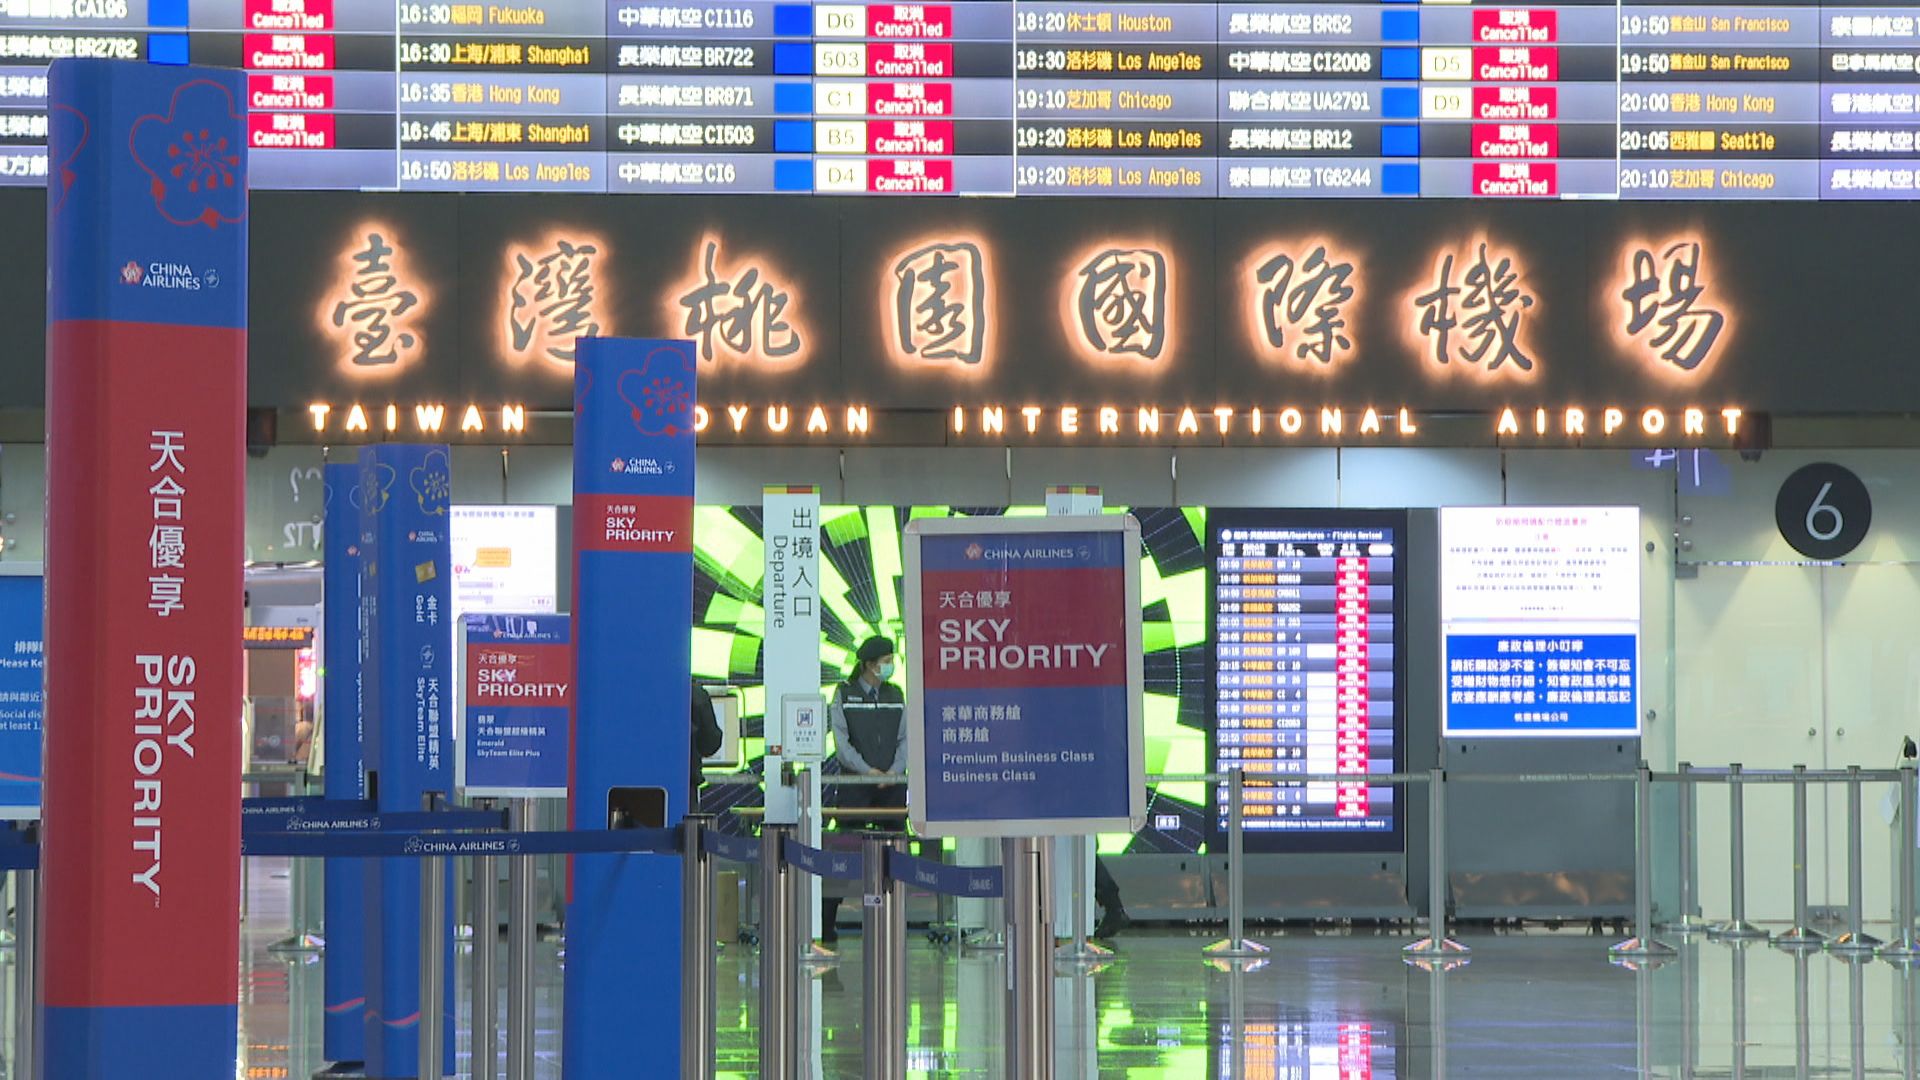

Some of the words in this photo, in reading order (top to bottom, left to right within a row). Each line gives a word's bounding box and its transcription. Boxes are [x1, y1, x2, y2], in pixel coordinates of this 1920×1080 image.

[252, 12, 324, 29] Cancelled
[401, 5, 451, 24] 16:30
[489, 6, 544, 24] Fukuoka
[704, 9, 754, 28] CI116
[828, 13, 854, 28] D6
[1017, 12, 1065, 32] 18:20
[1118, 14, 1172, 32] Houston
[1621, 15, 1669, 35] 19:50
[1711, 16, 1730, 32] San
[1734, 16, 1790, 32] Francisco
[875, 21, 943, 37] Cancelled
[1480, 26, 1548, 41] Cancelled
[252, 51, 324, 68] Cancelled
[401, 43, 451, 62] 16:30
[528, 44, 590, 66] Shanghai
[704, 47, 754, 66] BR722
[823, 52, 859, 67] 503
[1017, 50, 1065, 70] 18:30
[1118, 52, 1142, 70] Los
[1148, 52, 1202, 72] Angeles
[1434, 56, 1460, 72] D5
[1621, 54, 1669, 73] 19:50
[1711, 55, 1730, 70] San
[1734, 55, 1790, 70] Francisco
[875, 60, 943, 75] Cancelled
[1480, 64, 1548, 80] Cancelled
[253, 92, 324, 108] Cancelled
[401, 83, 451, 102] 16:35
[490, 85, 521, 104] Hong
[528, 85, 560, 104] Kong
[827, 90, 853, 106] C1
[1017, 89, 1065, 108] 19:10
[1118, 90, 1172, 109] Chicago
[1313, 92, 1370, 111] UA2791
[1434, 95, 1460, 111] D9
[1621, 93, 1669, 112] 20:00
[1706, 94, 1737, 113] Hong
[1743, 94, 1774, 113] Kong
[875, 99, 943, 114] Cancelled
[1480, 103, 1548, 118] Cancelled
[253, 131, 324, 147] Cancelled
[401, 121, 451, 141] 16:45
[528, 123, 590, 144] Shanghai
[829, 129, 854, 145] B5
[1017, 128, 1065, 147] 19:20
[1118, 129, 1142, 147] Los
[1148, 129, 1202, 149] Angeles
[1313, 130, 1352, 150] BR12
[1621, 131, 1669, 150] 20:05
[1721, 132, 1775, 150] Seattle
[875, 138, 943, 153] Cancelled
[1480, 141, 1548, 156] Cancelled
[401, 161, 451, 180] 16:50
[505, 162, 529, 180] Los
[536, 162, 590, 182] Angeles
[704, 164, 736, 183] CI6
[828, 167, 853, 184] D4
[1017, 167, 1065, 185] 19:20
[1118, 167, 1142, 185] Los
[1148, 167, 1202, 187] Angeles
[1621, 170, 1669, 188] 20:10
[1721, 170, 1774, 189] Chicago
[875, 176, 943, 191] Cancelled
[1480, 179, 1548, 194] Cancelled
[150, 263, 192, 276] CHINA
[142, 274, 200, 290] AIRLINES
[309, 404, 525, 433] TAIWAN
[694, 405, 868, 433] OYUAN
[954, 406, 1417, 436] INTERNATIONAL
[1497, 406, 1743, 436] AIRPORT
[624, 465, 662, 475] AIRLINES
[629, 459, 657, 467] CHINA
[1805, 482, 1844, 541] 6
[148, 430, 186, 617] 天合優享
[606, 517, 636, 528] SKY
[606, 529, 674, 542] PRIORITY
[792, 507, 813, 616] 出境入口
[985, 549, 1021, 560] CHINA
[1023, 548, 1074, 560] AIRLINES
[769, 536, 788, 629] Departure
[939, 591, 1011, 609] 天合優享
[415, 595, 424, 623] Gold
[427, 595, 437, 626] 金卡
[939, 618, 1011, 643] SKY
[939, 643, 1108, 671] PRIORITY
[477, 669, 516, 682] SKY
[477, 683, 568, 697] PRIORITY
[167, 655, 196, 758] SKY
[416, 677, 425, 732] SkyTeam
[942, 705, 1021, 722] 豪華商務艙
[9, 721, 31, 730] least
[477, 739, 505, 747] Emerald
[942, 727, 989, 744] 商務艙
[477, 749, 508, 758] SkyTeam
[509, 749, 524, 757] Elite
[525, 749, 541, 757] Plus
[942, 752, 998, 765] Premium
[1002, 752, 1057, 763] Business
[1061, 751, 1095, 762] Class
[133, 654, 163, 896] PRIORITY
[943, 771, 998, 783] Business
[1002, 770, 1036, 782] Class
[302, 821, 329, 829] CHINA
[331, 819, 368, 828] AIRLINES
[423, 842, 457, 852] CHINA
[459, 841, 505, 851] AIRLINES
